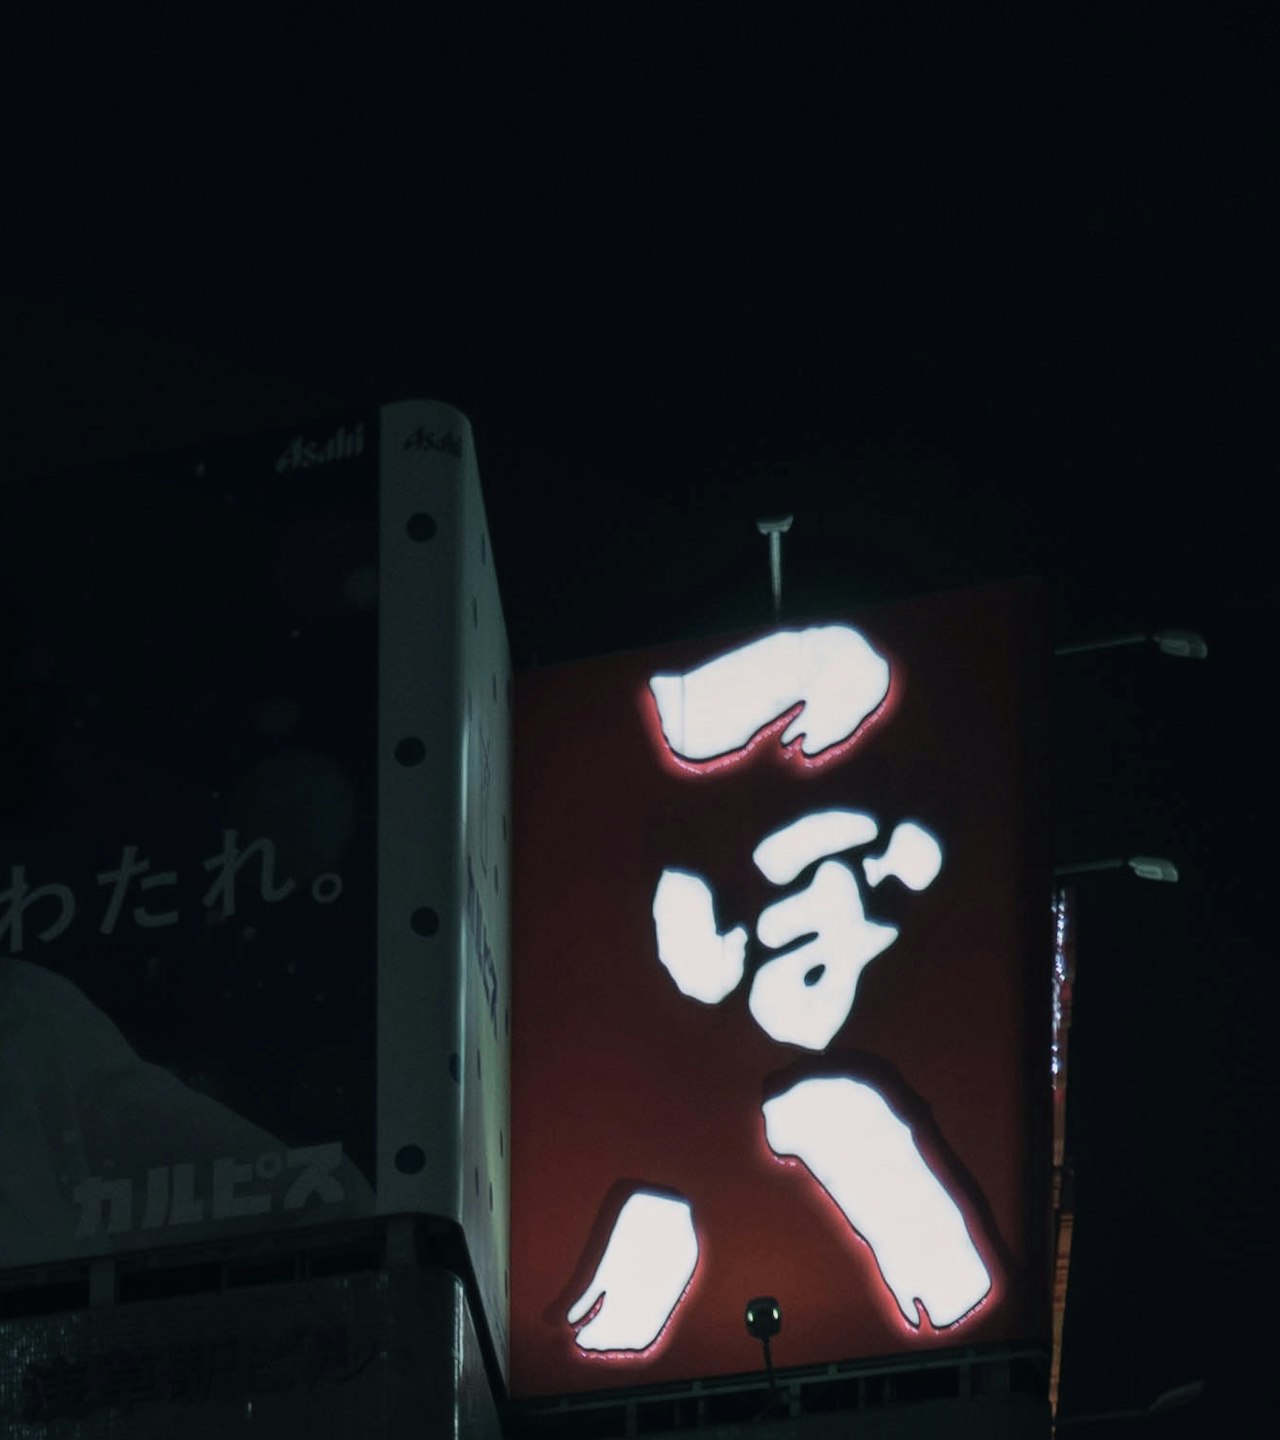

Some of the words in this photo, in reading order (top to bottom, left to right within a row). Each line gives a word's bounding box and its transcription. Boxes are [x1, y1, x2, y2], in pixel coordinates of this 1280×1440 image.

[274, 420, 365, 476] Asahi
[72, 1140, 346, 1242] カルピス
